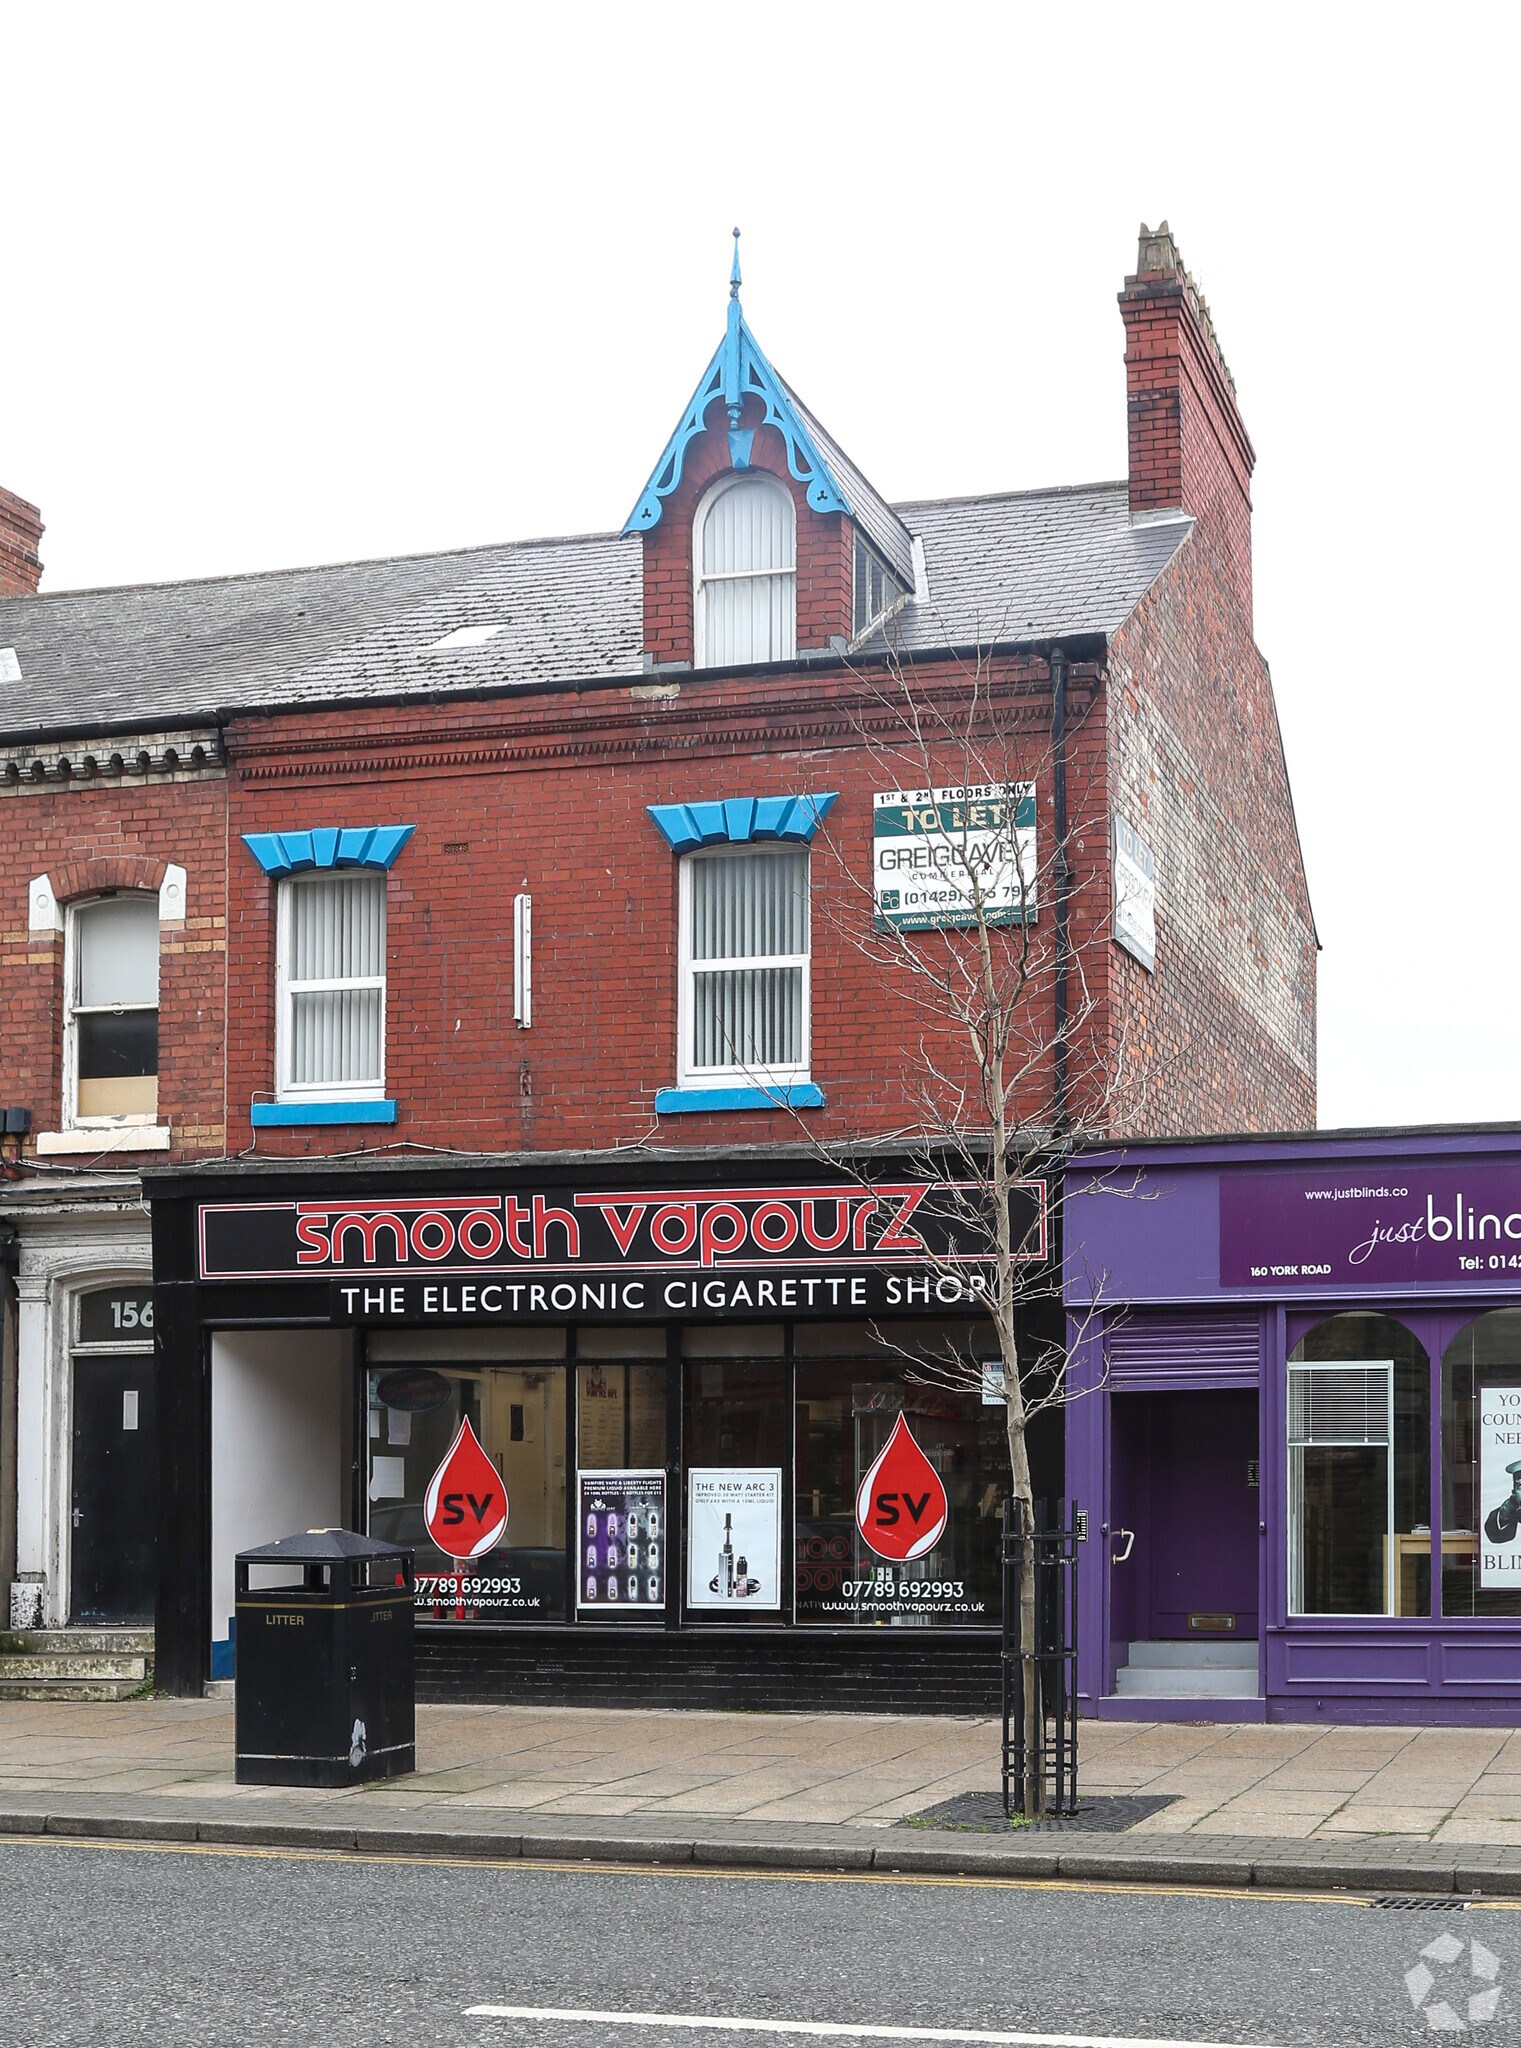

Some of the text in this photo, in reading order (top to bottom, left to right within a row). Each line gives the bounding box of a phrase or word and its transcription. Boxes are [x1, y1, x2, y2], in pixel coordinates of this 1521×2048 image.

[942, 786, 991, 800] FLOORS
[902, 804, 1007, 831] TO LET
[904, 891, 963, 906] (01429)
[1304, 1186, 1408, 1201] www.justblinds.co
[296, 1195, 581, 1265] smooth
[1349, 1216, 1426, 1264] just
[1250, 1264, 1331, 1277] 160 YORK ROAD
[1458, 1256, 1484, 1270] Tel:
[340, 1275, 986, 1315] THE ELECTRONIC CIGARETTE SHOP
[111, 1301, 154, 1328] 156
[1498, 1394, 1520, 1407] YO
[696, 1483, 774, 1491] THE NEW ARC 3
[443, 1494, 494, 1525] SV
[876, 1493, 931, 1526] SV
[461, 1578, 521, 1594] 692993
[842, 1581, 964, 1598] 07789 692993
[822, 1600, 985, 1613] www.smoothvapourz.co.uk
[266, 1614, 304, 1626] LITTER
[371, 1611, 393, 1623] ITTER
